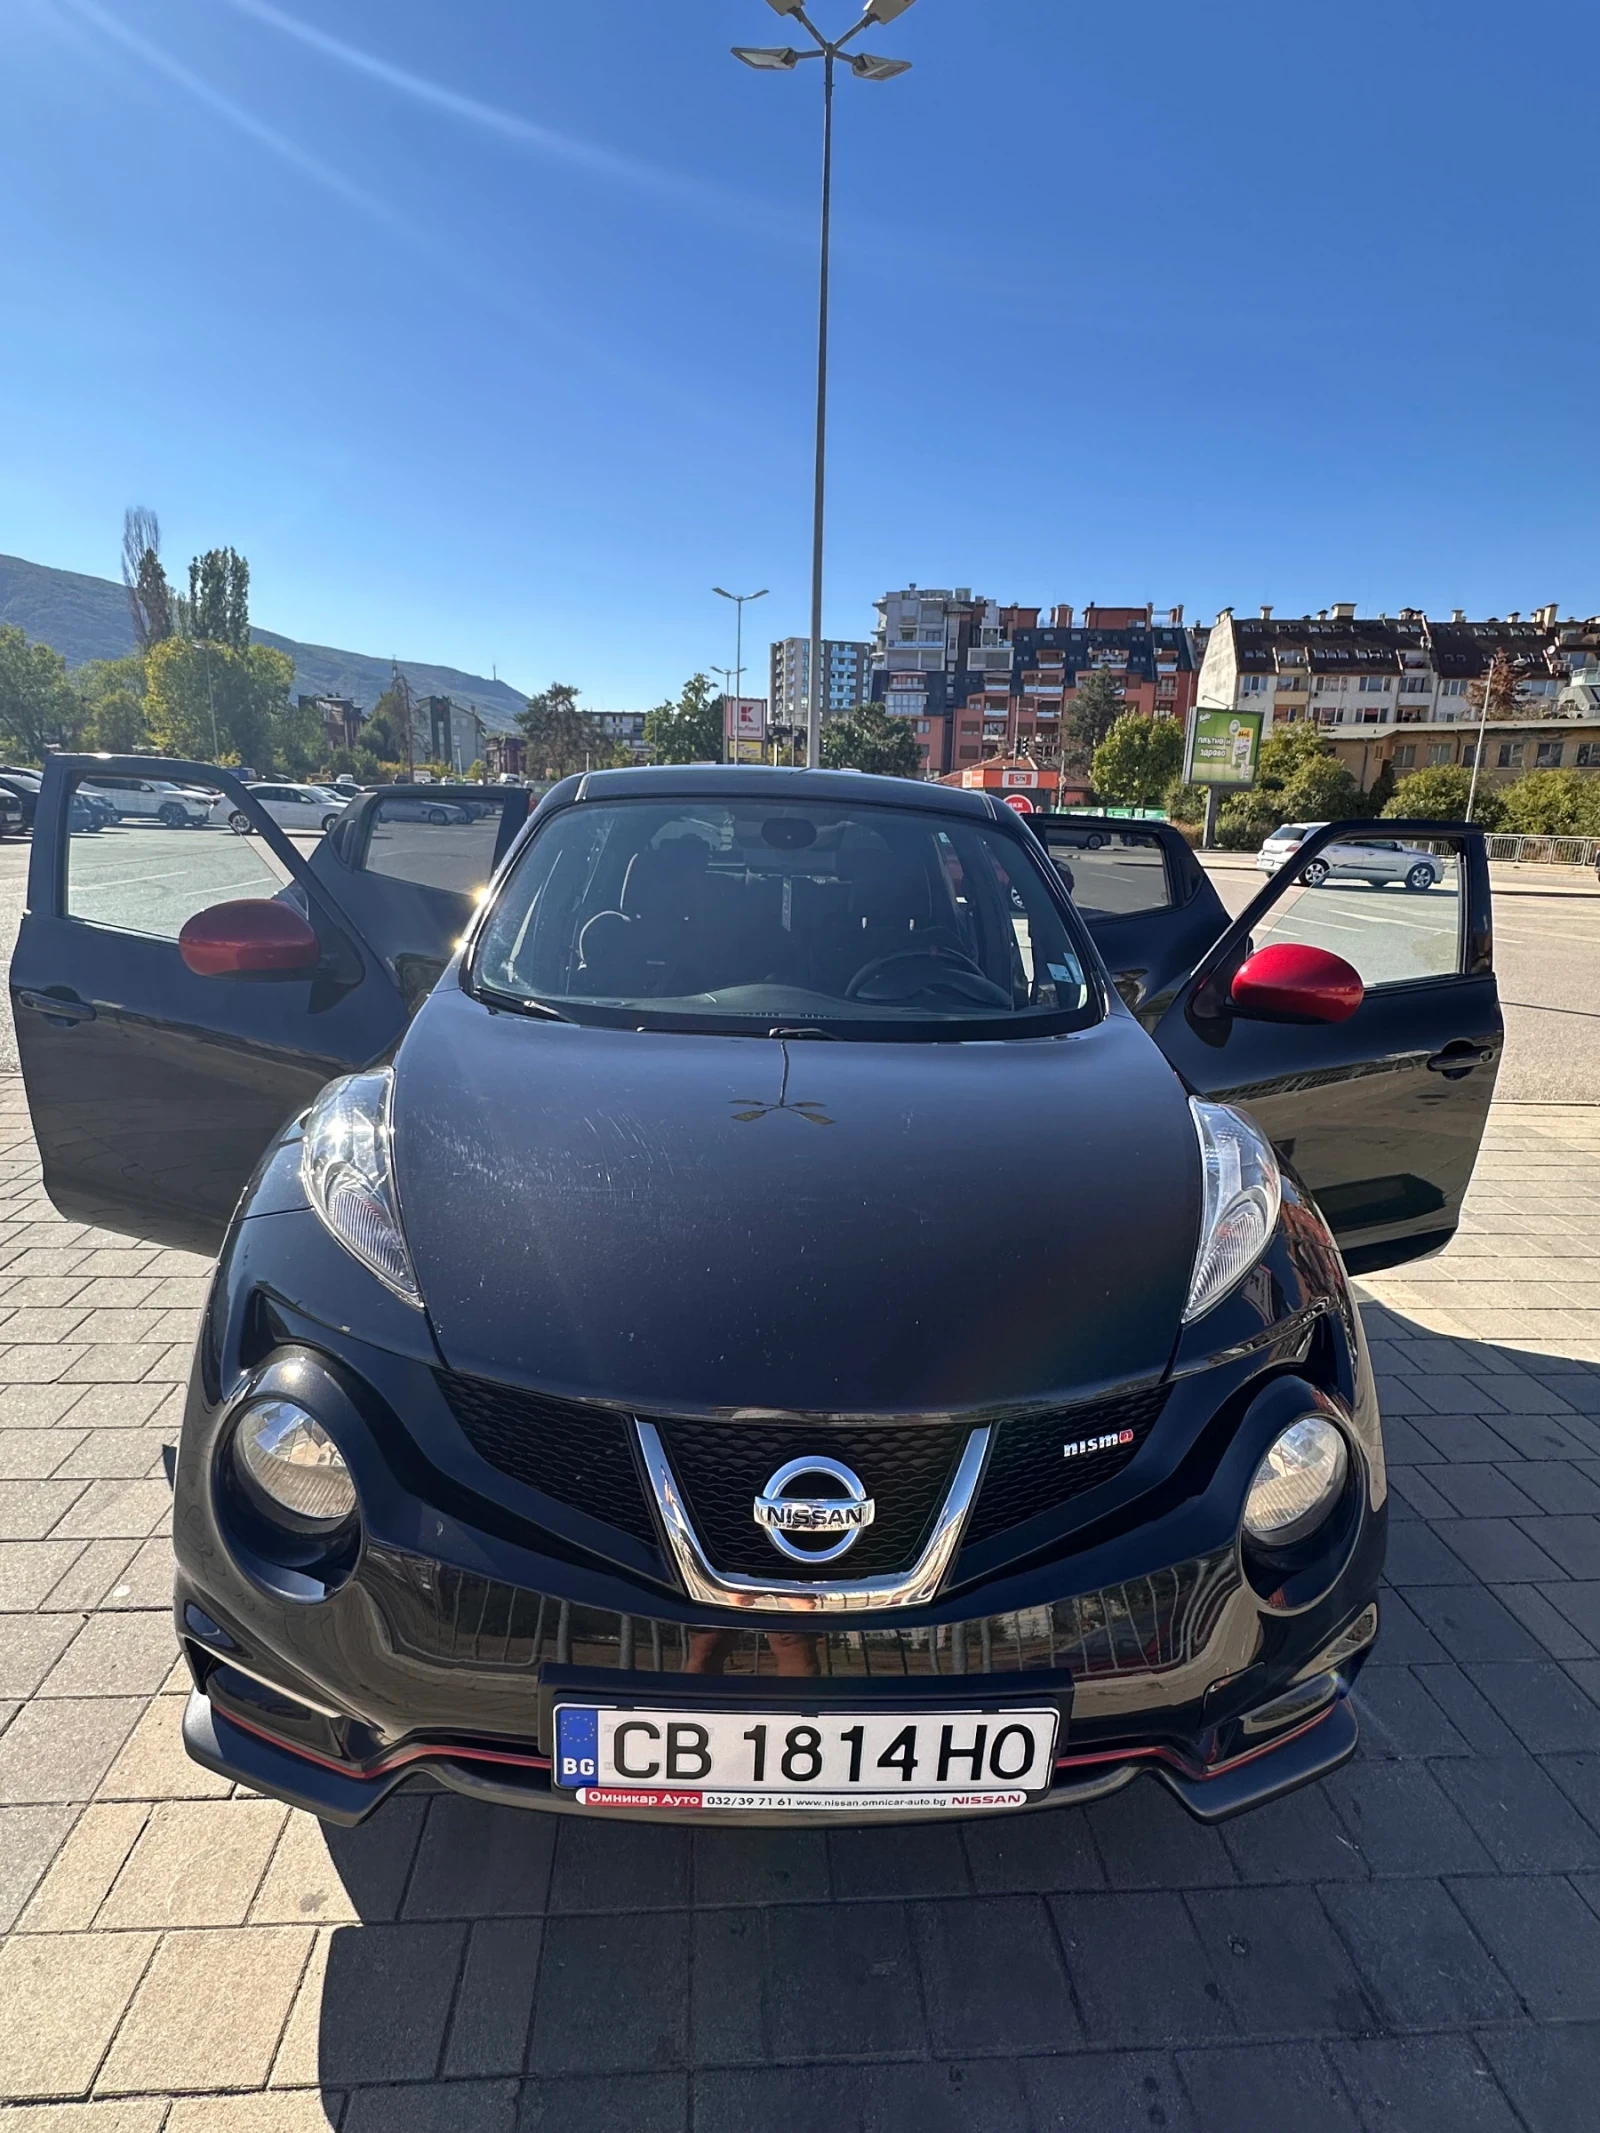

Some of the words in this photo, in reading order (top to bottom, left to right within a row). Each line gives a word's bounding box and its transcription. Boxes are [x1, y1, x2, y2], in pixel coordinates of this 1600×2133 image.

[767, 1505, 862, 1525] NISSAN
[613, 1721, 712, 1779] CB
[743, 1724, 919, 1782] 1814
[936, 1723, 1036, 1781] HO
[563, 1757, 595, 1776] BG
[588, 1791, 658, 1806] Омникар
[661, 1794, 700, 1806] Ауто
[706, 1796, 755, 1806] 032/39
[758, 1797, 773, 1806] 71
[777, 1797, 793, 1806] 61
[796, 1798, 947, 1807] www.nissan.omnicar-auto.bg
[951, 1794, 1021, 1805] NISSAN
